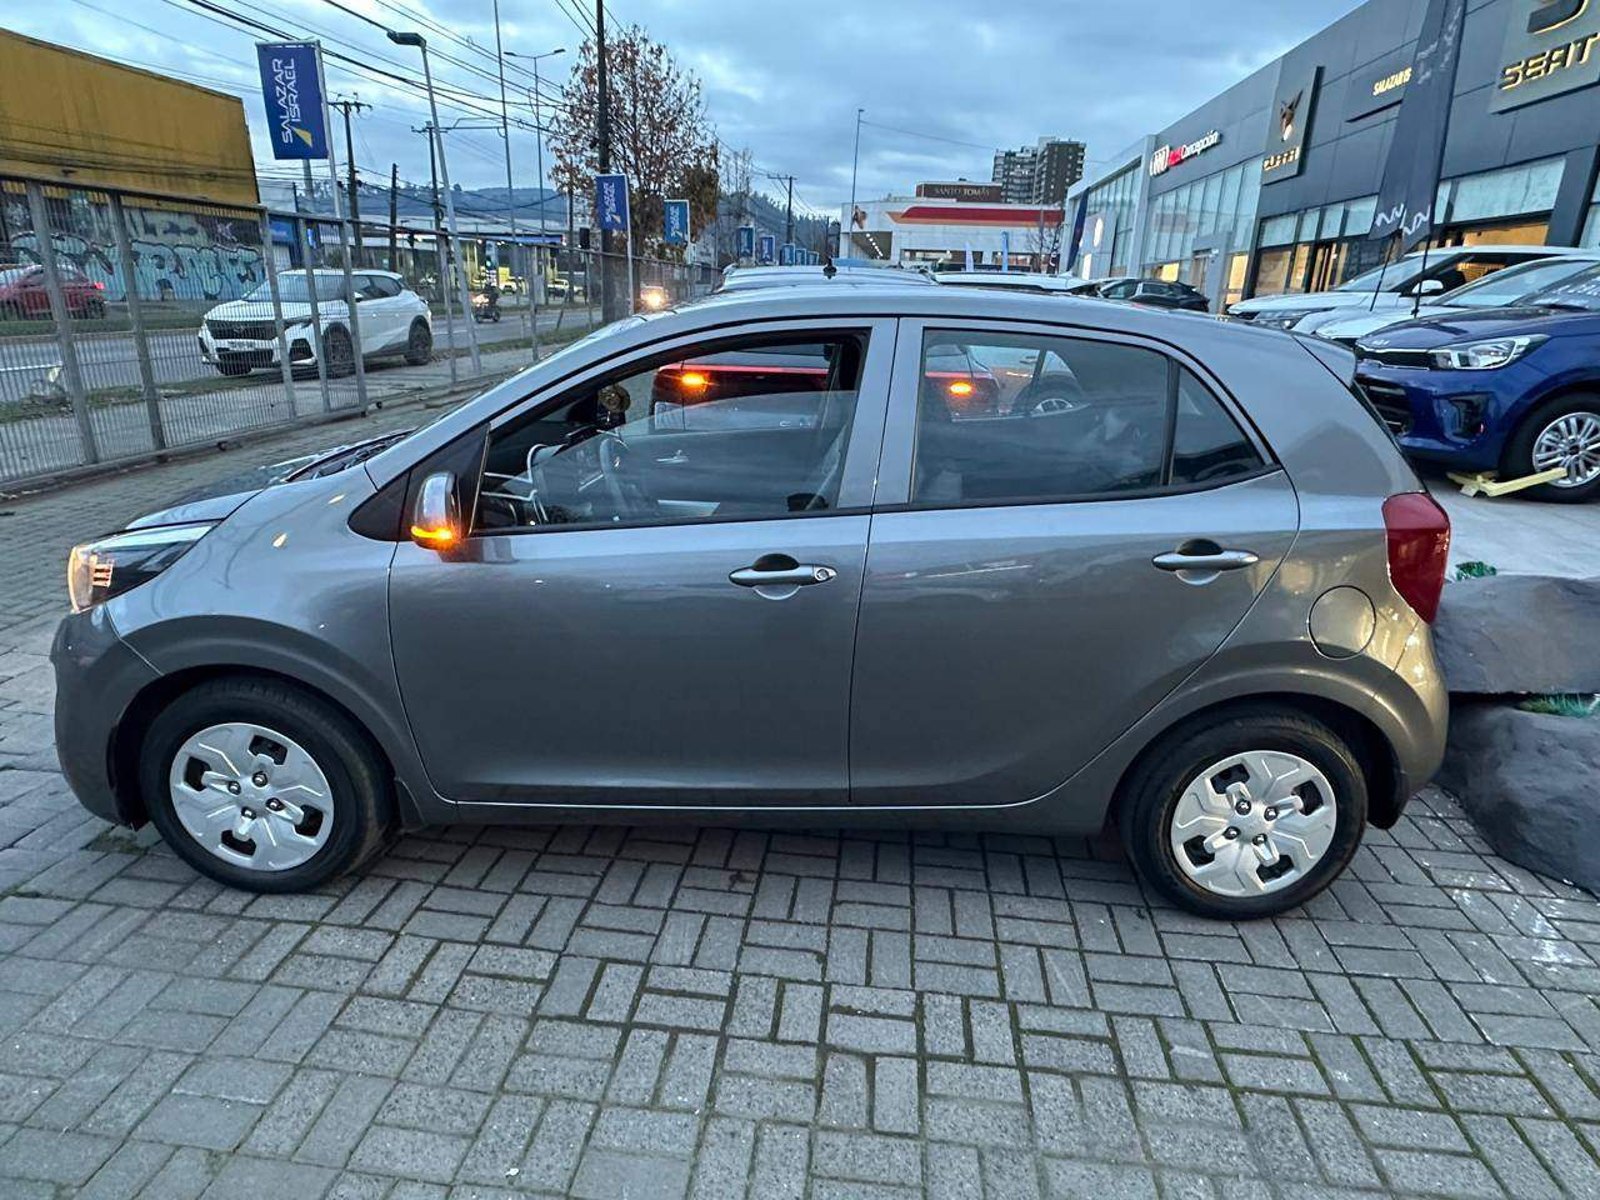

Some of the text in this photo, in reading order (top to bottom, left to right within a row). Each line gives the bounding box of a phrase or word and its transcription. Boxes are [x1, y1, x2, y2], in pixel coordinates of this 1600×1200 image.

[284, 58, 302, 122] ISRAEL
[1498, 32, 1600, 91] SEAT
[272, 58, 293, 144] SALAZAR
